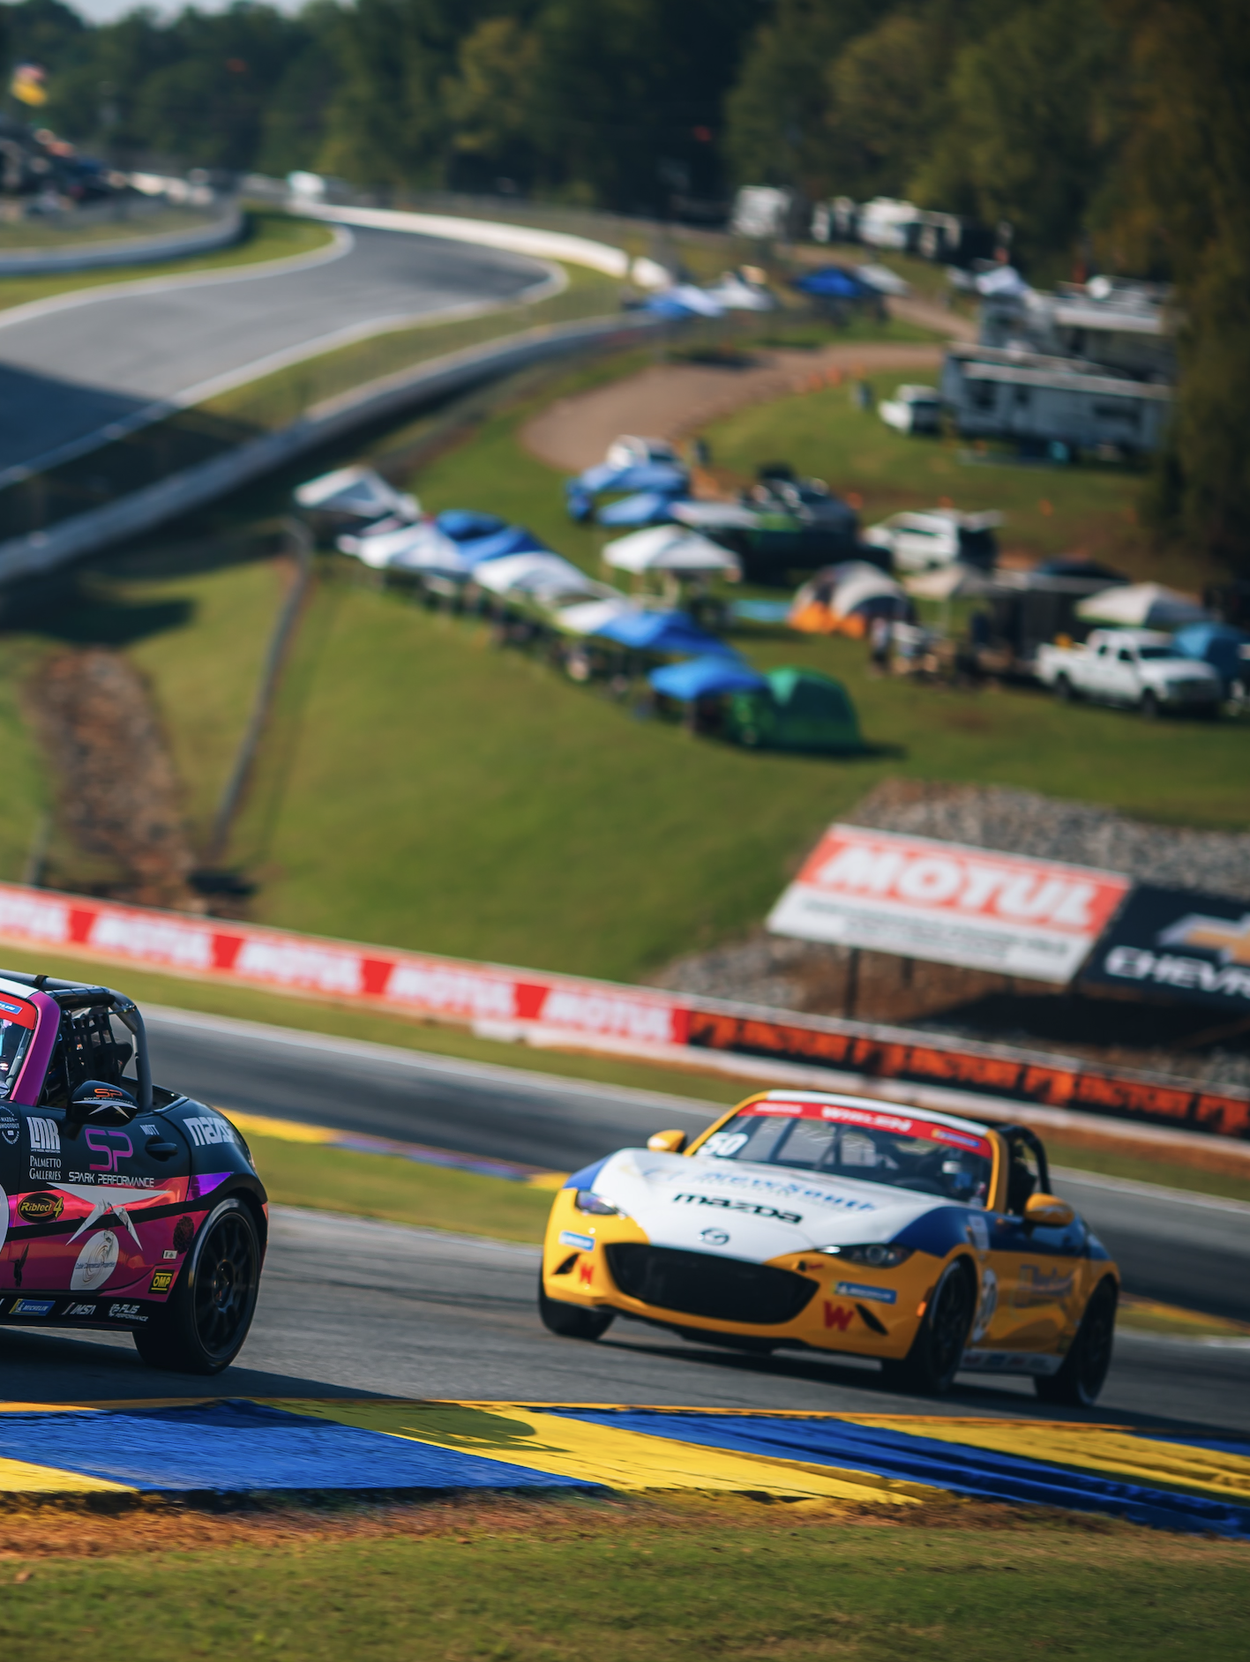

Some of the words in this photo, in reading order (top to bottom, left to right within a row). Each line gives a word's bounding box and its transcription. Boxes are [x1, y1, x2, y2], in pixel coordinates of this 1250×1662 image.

[818, 846, 1098, 927] MOTUL
[94, 1088, 123, 1098] SP
[26, 1116, 61, 1150] LMR
[85, 1129, 133, 1172] SP
[29, 1155, 62, 1168] PALMETTO
[29, 1168, 62, 1181] GALLERIES
[68, 1171, 95, 1183] SPARK
[97, 1173, 155, 1188] PERFORMANCE
[53, 1196, 64, 1218] 4
[673, 1193, 804, 1224] mazda
[152, 1276, 172, 1288] OMP
[22, 1303, 49, 1312] MICHELIN
[69, 1304, 97, 1316] IMSA
